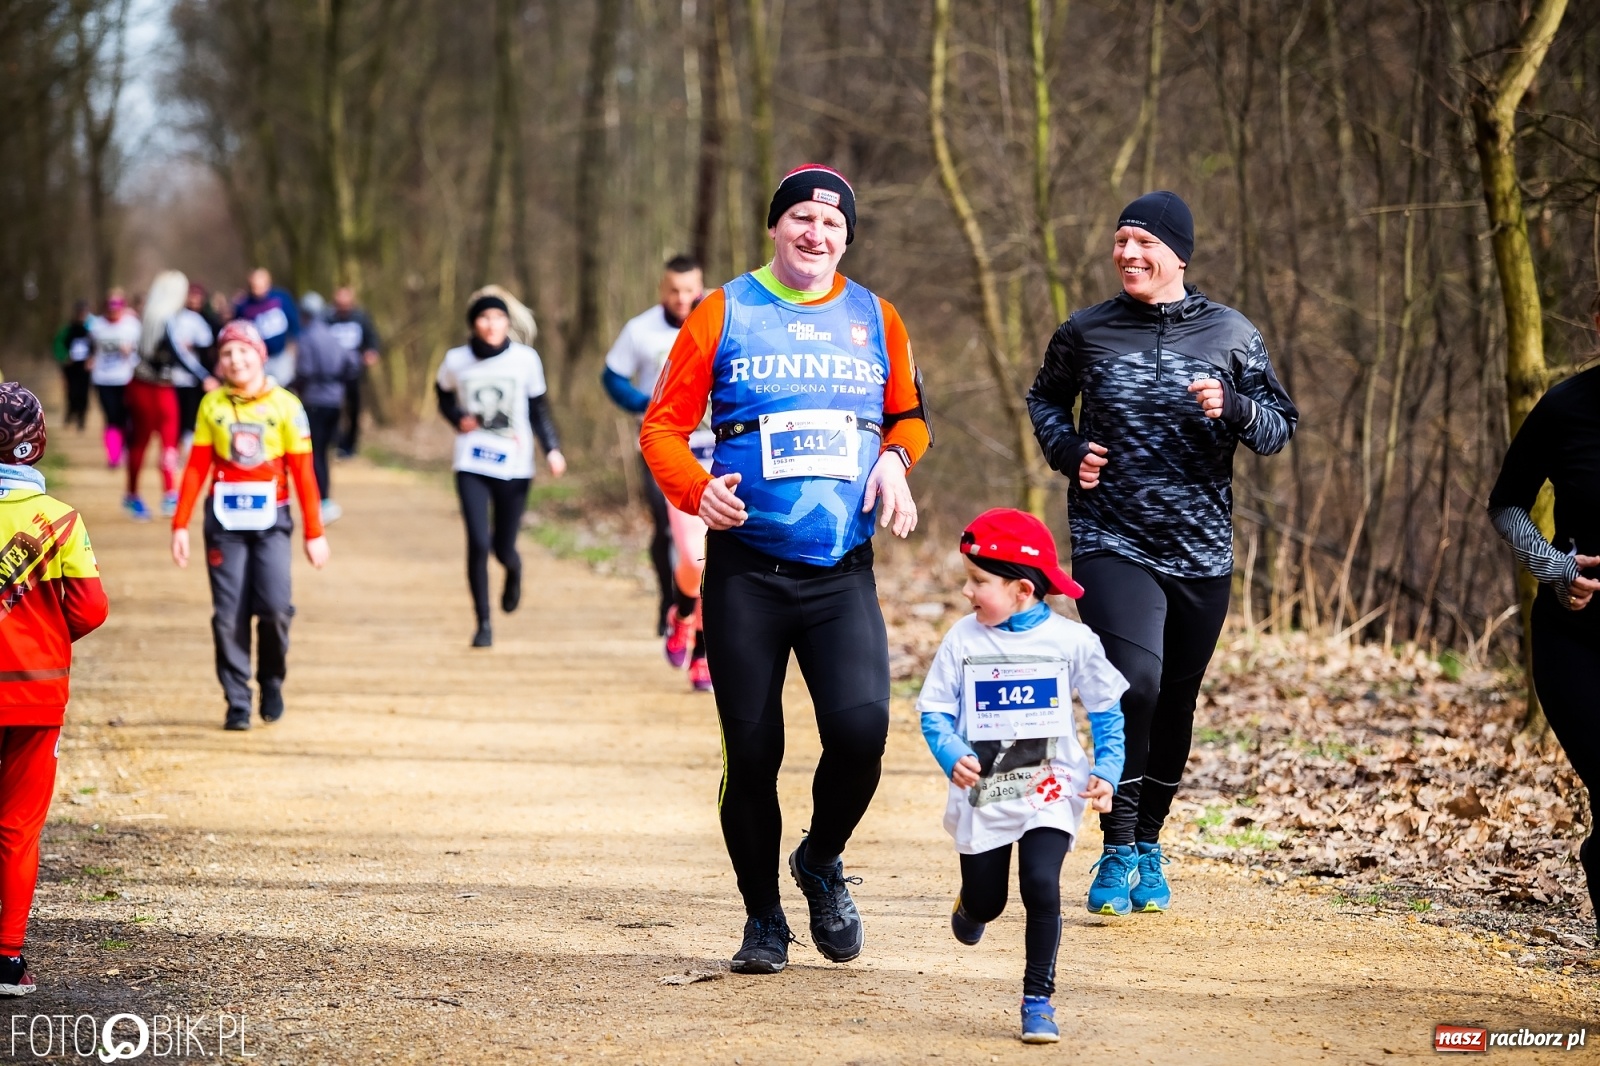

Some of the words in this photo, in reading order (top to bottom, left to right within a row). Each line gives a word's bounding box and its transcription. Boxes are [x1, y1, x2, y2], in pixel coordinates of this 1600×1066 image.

[729, 353, 887, 386] RUNNERS
[831, 384, 867, 396] TEAM
[792, 434, 826, 451] 141
[773, 458, 788, 466] 1963
[997, 685, 1036, 705] 142
